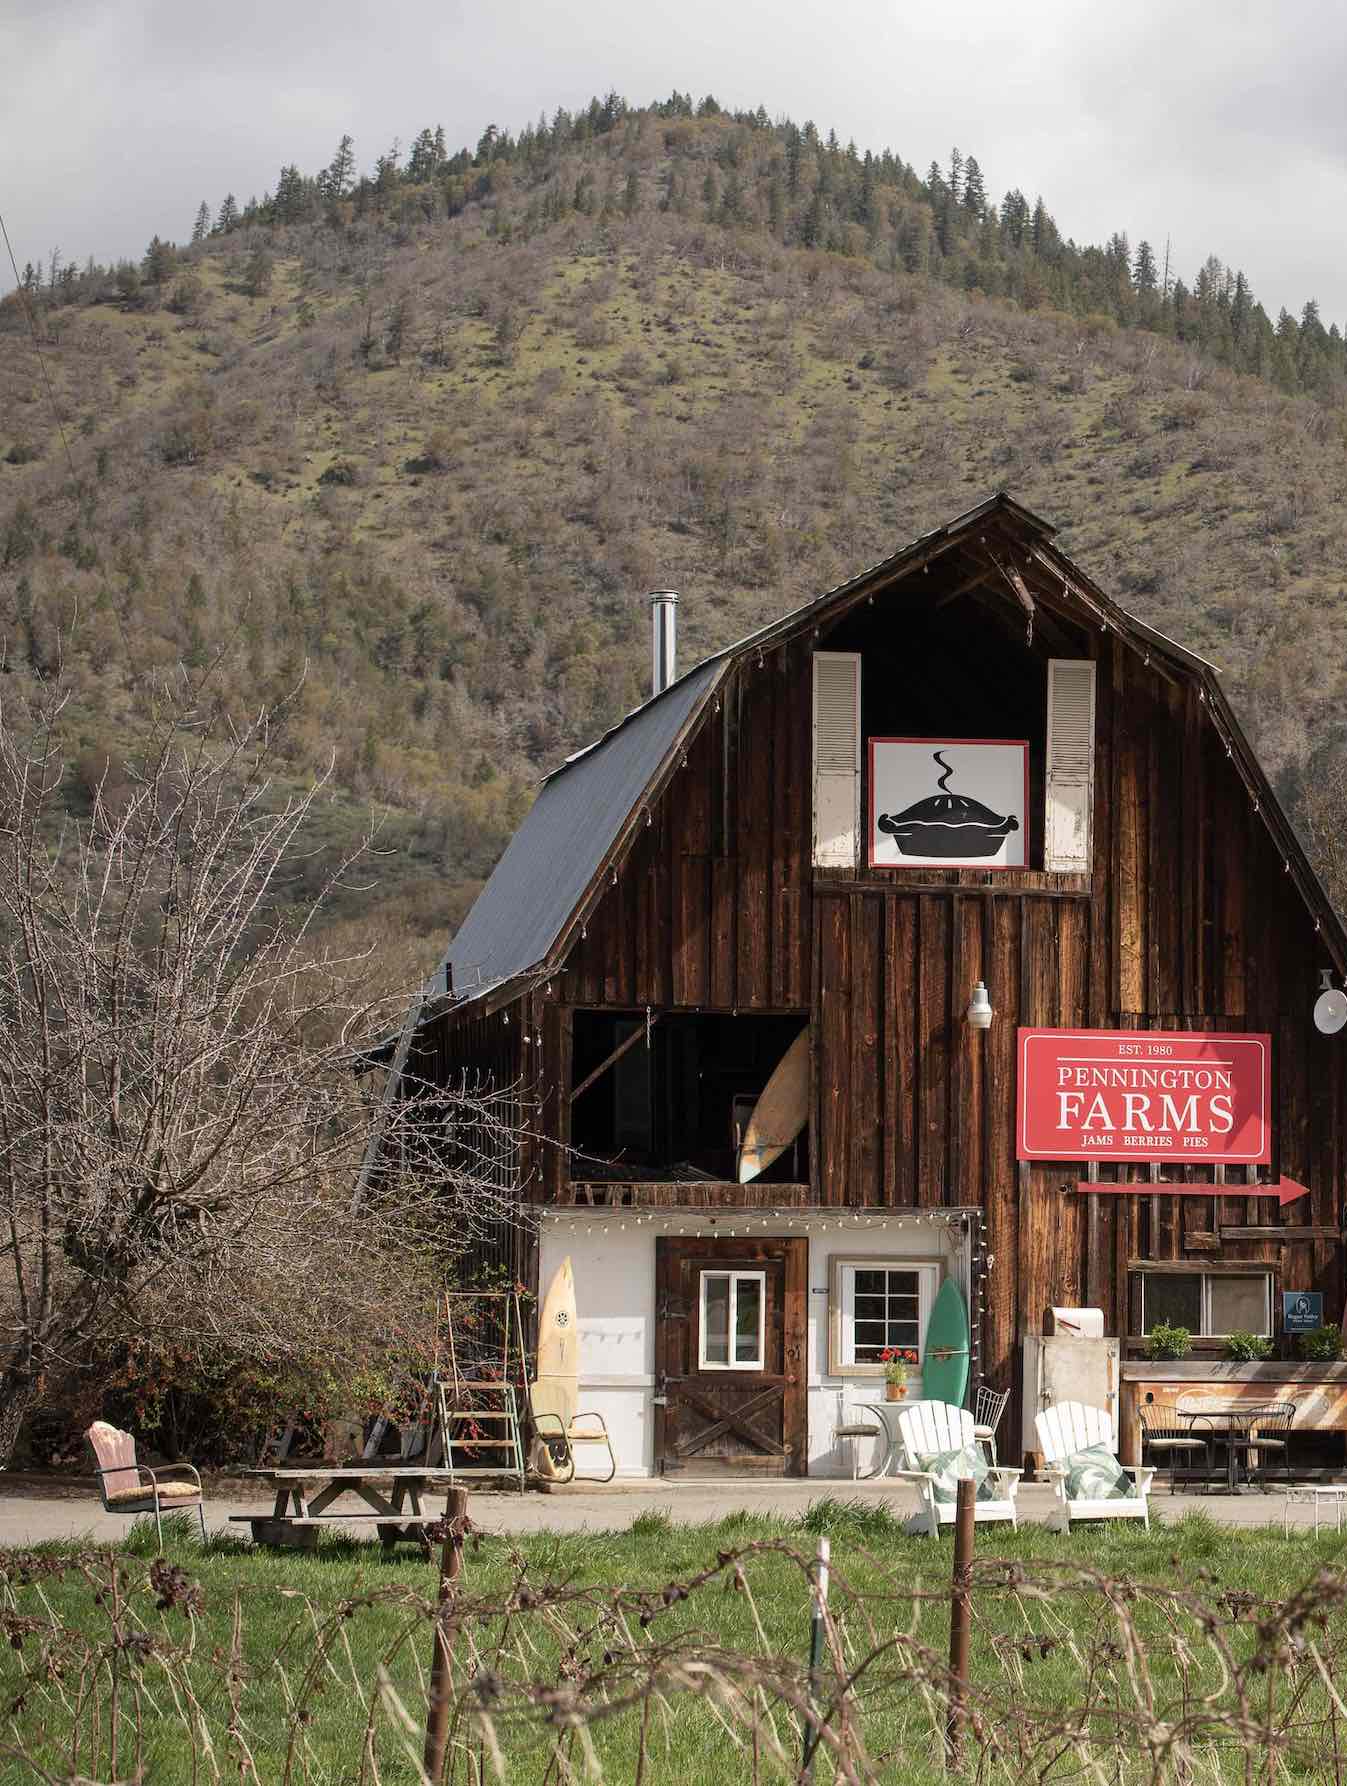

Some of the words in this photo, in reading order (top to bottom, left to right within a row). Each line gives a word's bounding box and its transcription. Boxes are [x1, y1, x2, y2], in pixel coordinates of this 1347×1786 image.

[1119, 1044, 1143, 1056] EST.
[1147, 1045, 1173, 1056] 1980
[1056, 1066, 1233, 1089] PENNINGTON
[1056, 1092, 1235, 1134] FARMS
[1081, 1135, 1113, 1147] JAMS
[1124, 1135, 1173, 1147] BERRIES
[1183, 1136, 1208, 1148] PIES
